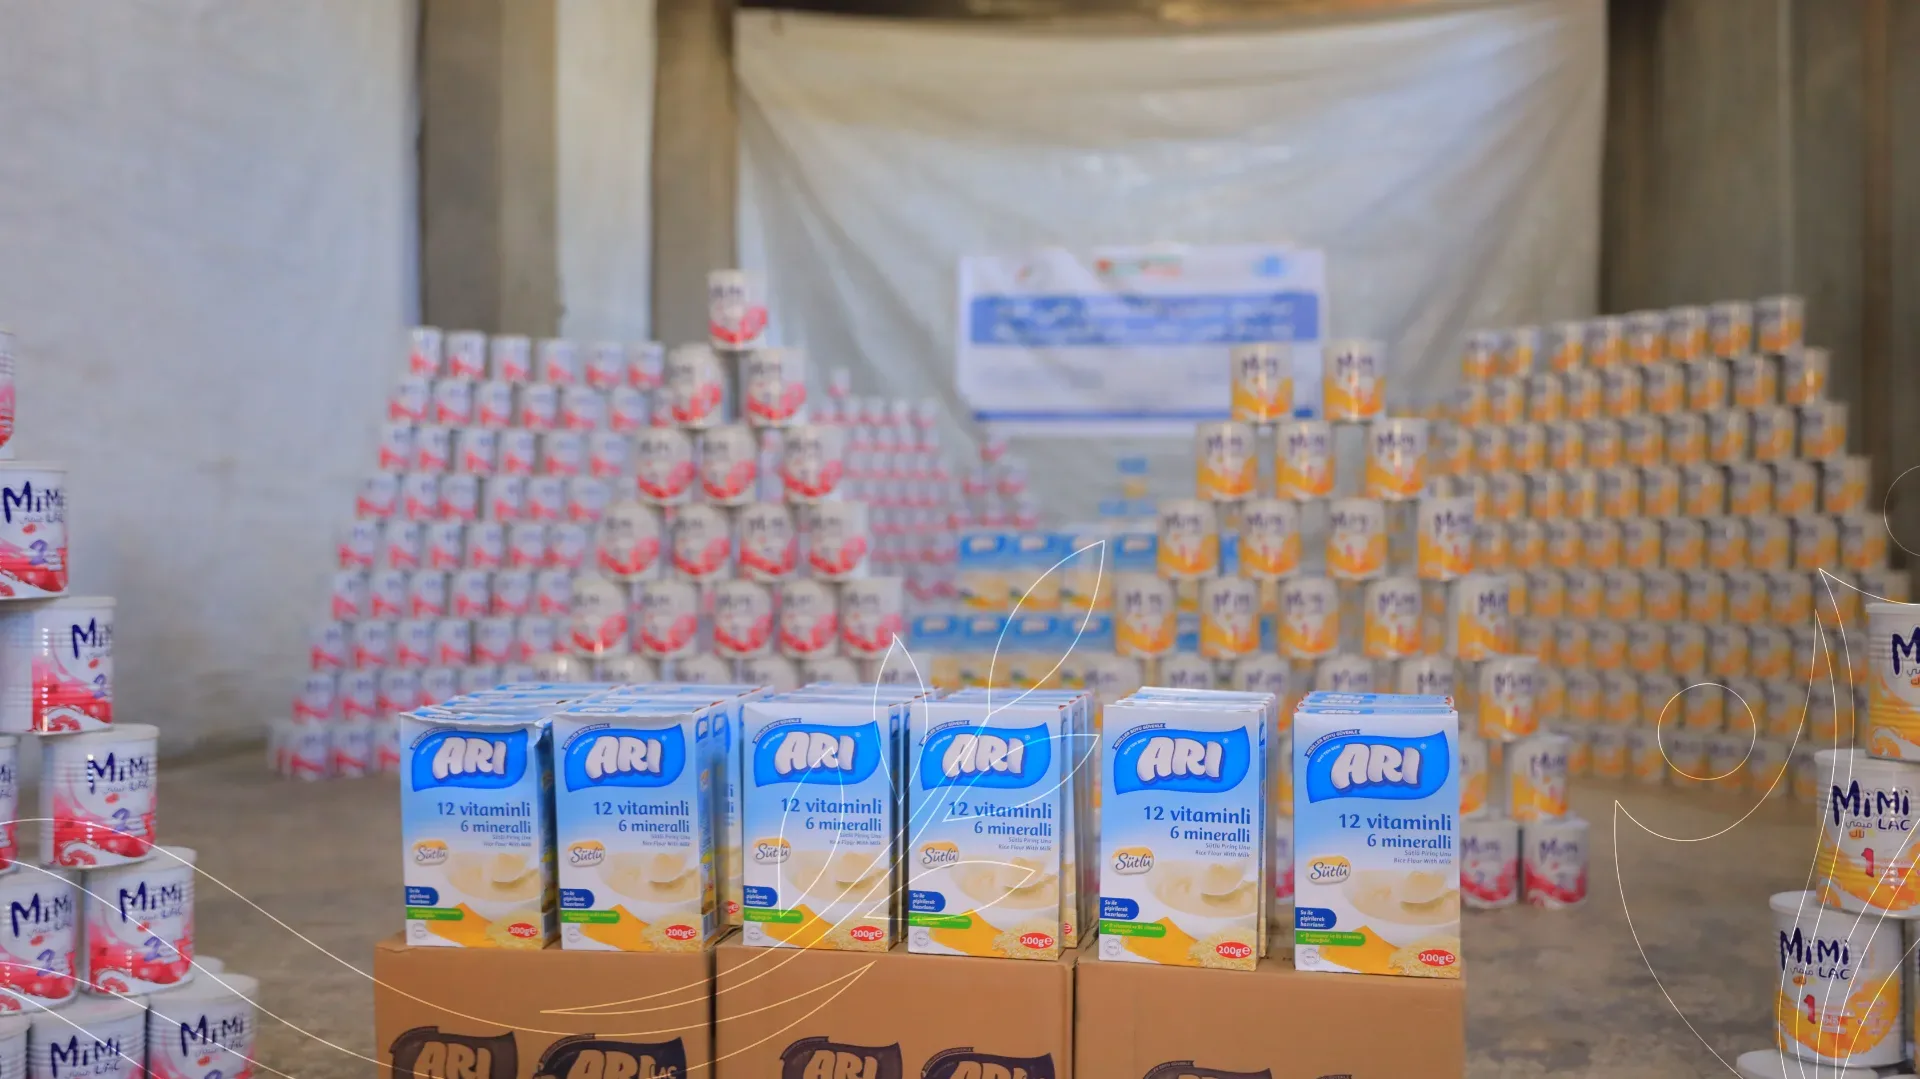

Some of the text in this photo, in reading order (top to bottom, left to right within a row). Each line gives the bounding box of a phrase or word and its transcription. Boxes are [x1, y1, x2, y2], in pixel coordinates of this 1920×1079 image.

[432, 737, 507, 780] ARI
[585, 736, 662, 779] ARI
[774, 731, 855, 775] ARI
[942, 733, 1024, 778] ARI
[1136, 736, 1223, 782] ARI
[1330, 743, 1420, 790] ARI
[437, 801, 531, 817] 12 vitaminli
[593, 800, 690, 816] 12 vitaminli
[781, 798, 882, 815] 12 vitaminli
[949, 801, 1052, 819] 12 vitaminli
[1832, 780, 1910, 827] MiMi
[111, 807, 132, 834] 2
[806, 817, 882, 831] 6 mineralli
[1144, 805, 1251, 825] 12 vitaminli
[1339, 813, 1452, 833] 12 vitaminli
[1878, 818, 1912, 831] LAC
[461, 820, 531, 833] 6 mineralli
[619, 819, 690, 833] 6 mineralli
[974, 821, 1052, 836] 6 mineralli
[1170, 825, 1251, 843] 6 mineralli
[1367, 833, 1376, 847] 6
[1382, 833, 1452, 850] mineralli
[570, 846, 603, 863] Sütlü
[922, 847, 957, 865] Sütlü
[1115, 852, 1151, 871] Sütlü
[1861, 847, 1875, 878] 1
[1310, 861, 1348, 880] Sütlü
[143, 935, 162, 962] 2
[1780, 927, 1850, 972] MiMi
[36, 948, 56, 977] 2
[1818, 966, 1851, 980] LAC
[1803, 994, 1816, 1025] 1
[413, 1041, 492, 1079] ARI
